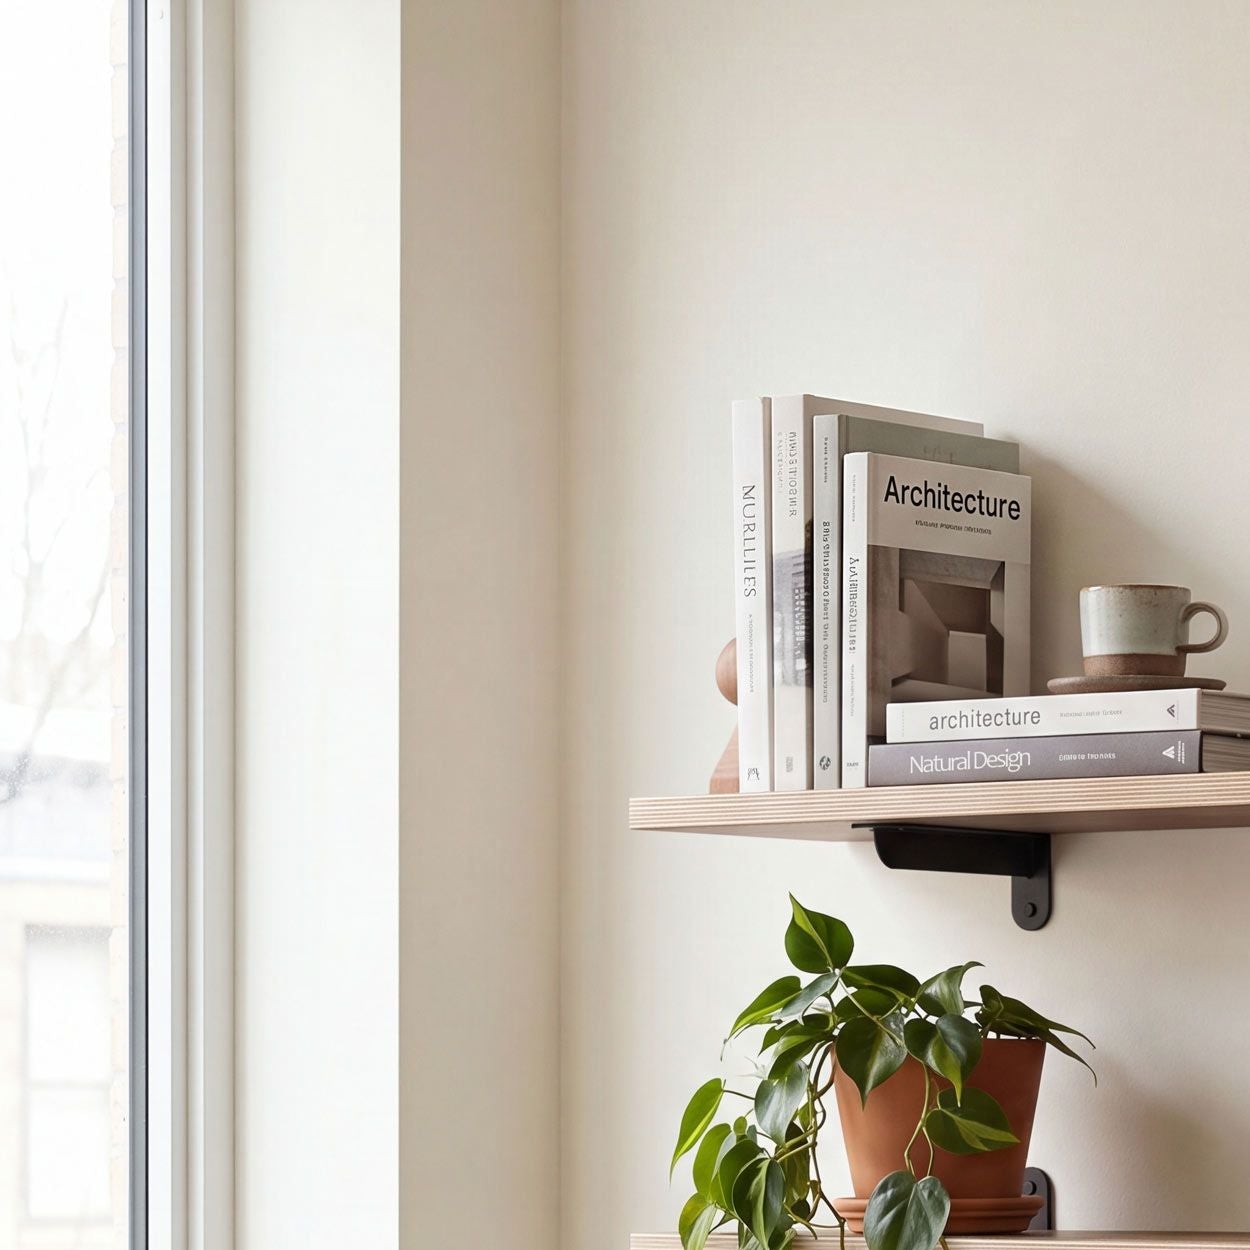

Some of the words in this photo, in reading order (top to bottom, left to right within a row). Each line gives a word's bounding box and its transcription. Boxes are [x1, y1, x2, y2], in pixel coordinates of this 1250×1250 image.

[884, 475, 1021, 521] Architecture
[929, 708, 1041, 731] architecture
[909, 750, 971, 774] Natural
[974, 748, 1031, 773] Design
